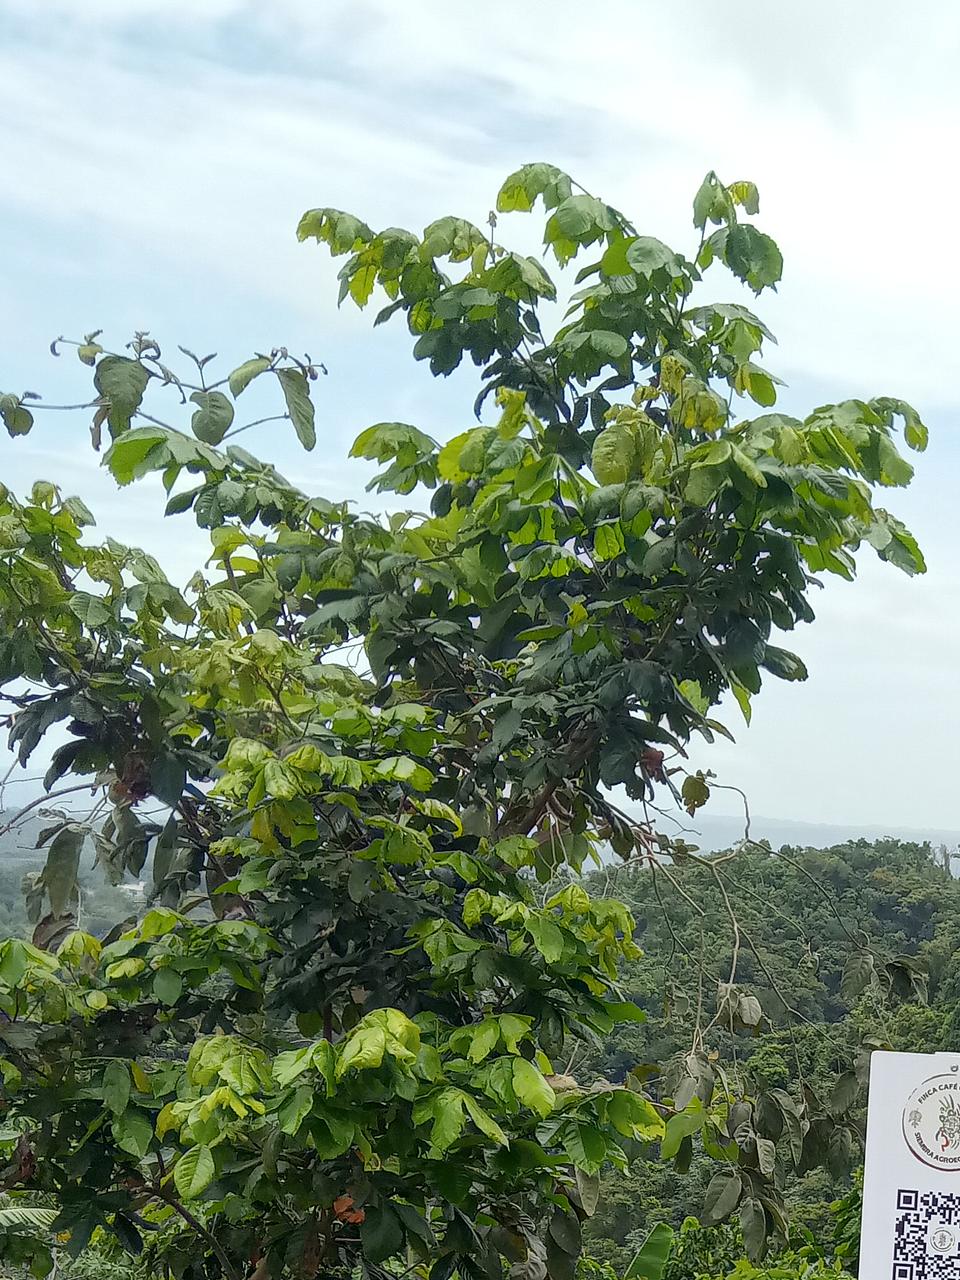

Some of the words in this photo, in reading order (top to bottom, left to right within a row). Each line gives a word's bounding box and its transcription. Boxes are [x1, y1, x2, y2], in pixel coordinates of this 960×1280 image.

[918, 1087, 938, 1104] FINCA
[938, 1083, 958, 1091] CAFÉ
[915, 1132, 934, 1158] SIEMBRA
